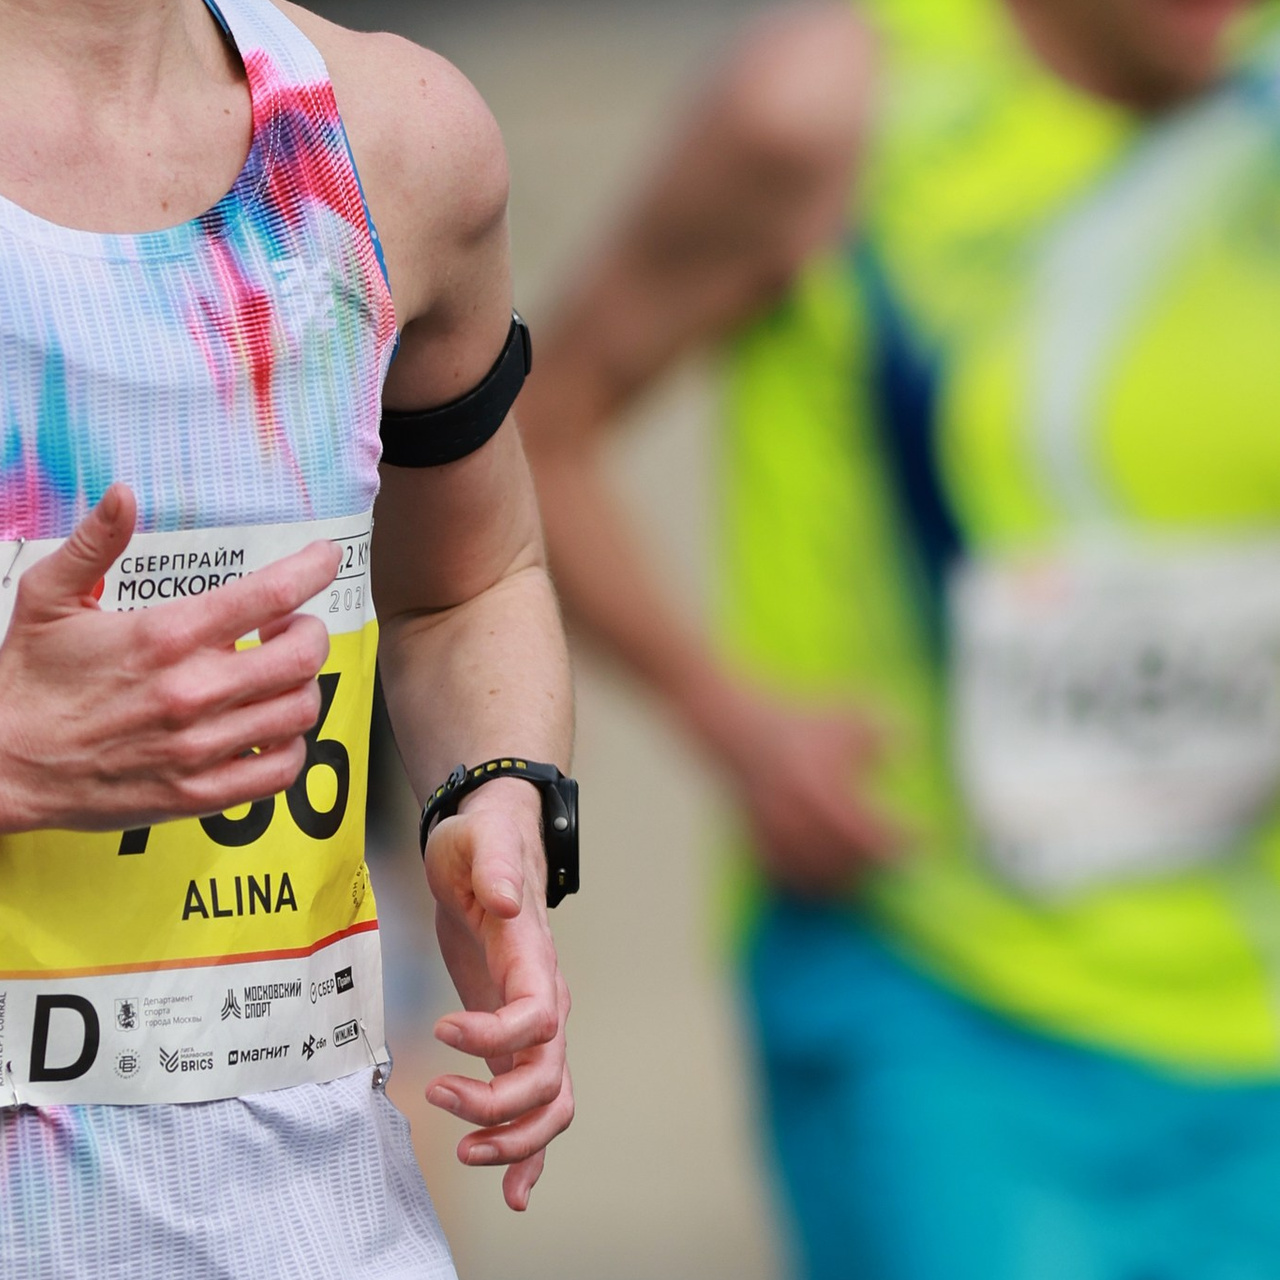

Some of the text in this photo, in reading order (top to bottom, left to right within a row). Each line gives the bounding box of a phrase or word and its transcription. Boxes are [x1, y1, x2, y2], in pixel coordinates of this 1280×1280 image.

[120, 547, 244, 574] СБЕРПРАЙМ
[329, 583, 366, 613] 202
[181, 872, 298, 921] ALINA
[244, 978, 302, 1002] МОСКОВСКИЙ
[317, 978, 335, 997] СБЕР
[144, 995, 194, 1007] Департамент
[245, 1001, 272, 1019] СПОРТ
[144, 1008, 171, 1017] спорта
[145, 1016, 203, 1028] города Москвы
[28, 993, 100, 1083] D
[240, 1045, 290, 1062] магнит
[180, 1058, 214, 1072] BRICS
